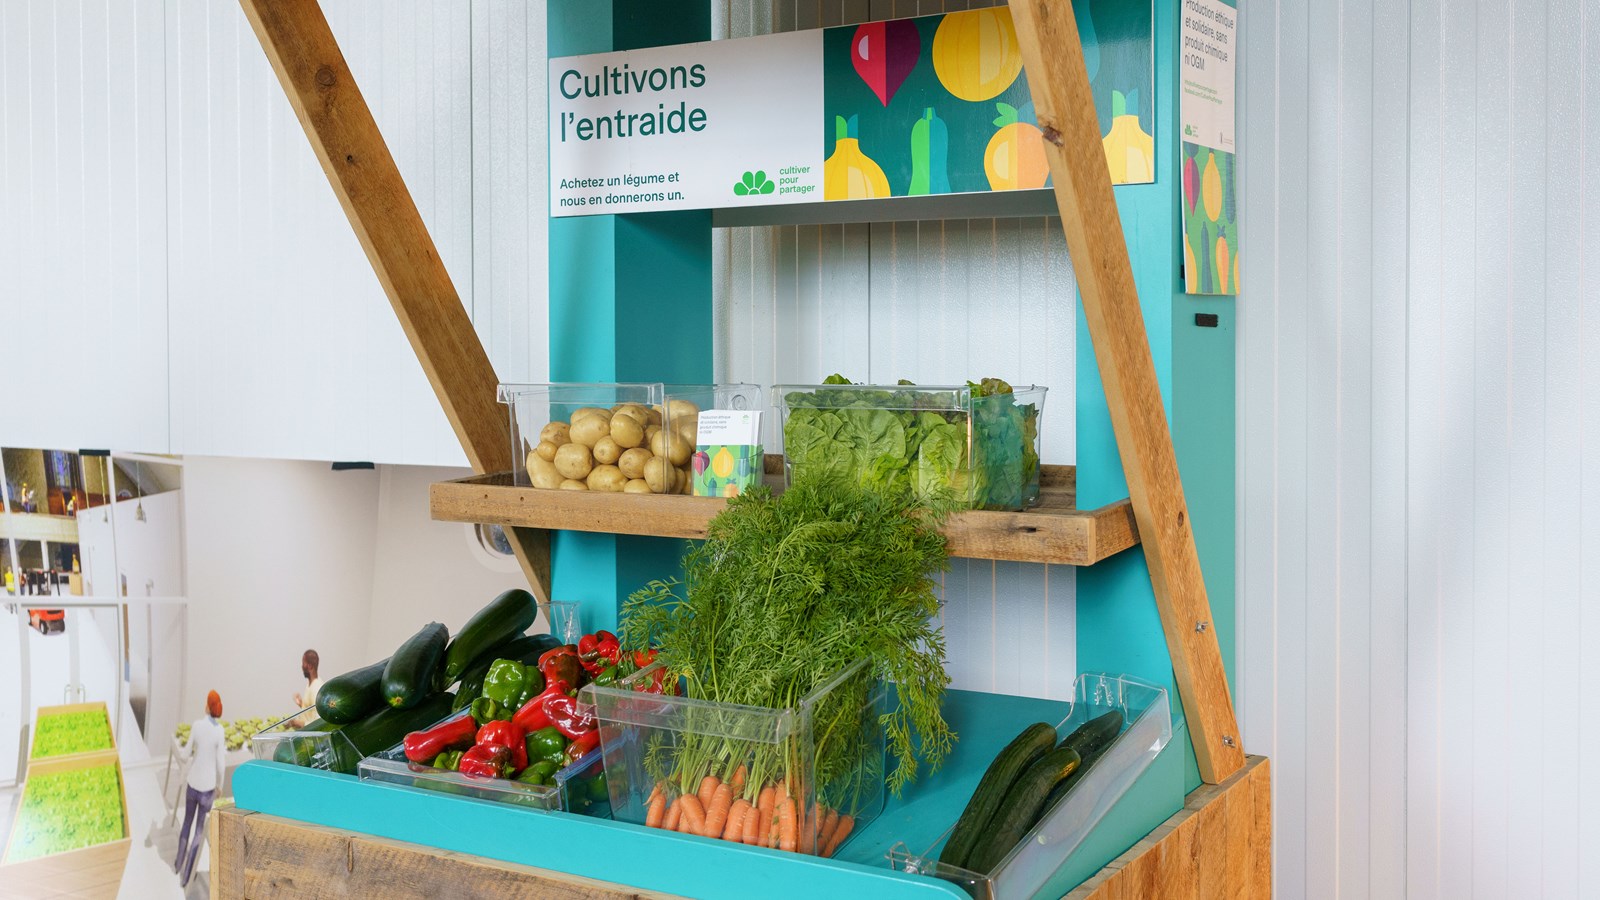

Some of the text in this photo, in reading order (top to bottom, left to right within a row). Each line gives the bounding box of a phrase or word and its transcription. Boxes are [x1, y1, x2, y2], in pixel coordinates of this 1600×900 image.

[1185, 0, 1234, 30] Production éthique
[1185, 16, 1228, 44] et solidaire, sans
[1185, 35, 1228, 63] produit chimique
[1185, 52, 1205, 70] ni OGM
[559, 63, 707, 100] Cultivons
[561, 101, 707, 142] l’entraide
[779, 165, 811, 175] cultiver
[560, 171, 680, 189] Achetez un légume et
[779, 176, 799, 186] pour
[560, 190, 685, 207] nous en donnerons un.
[779, 184, 815, 196] partager
